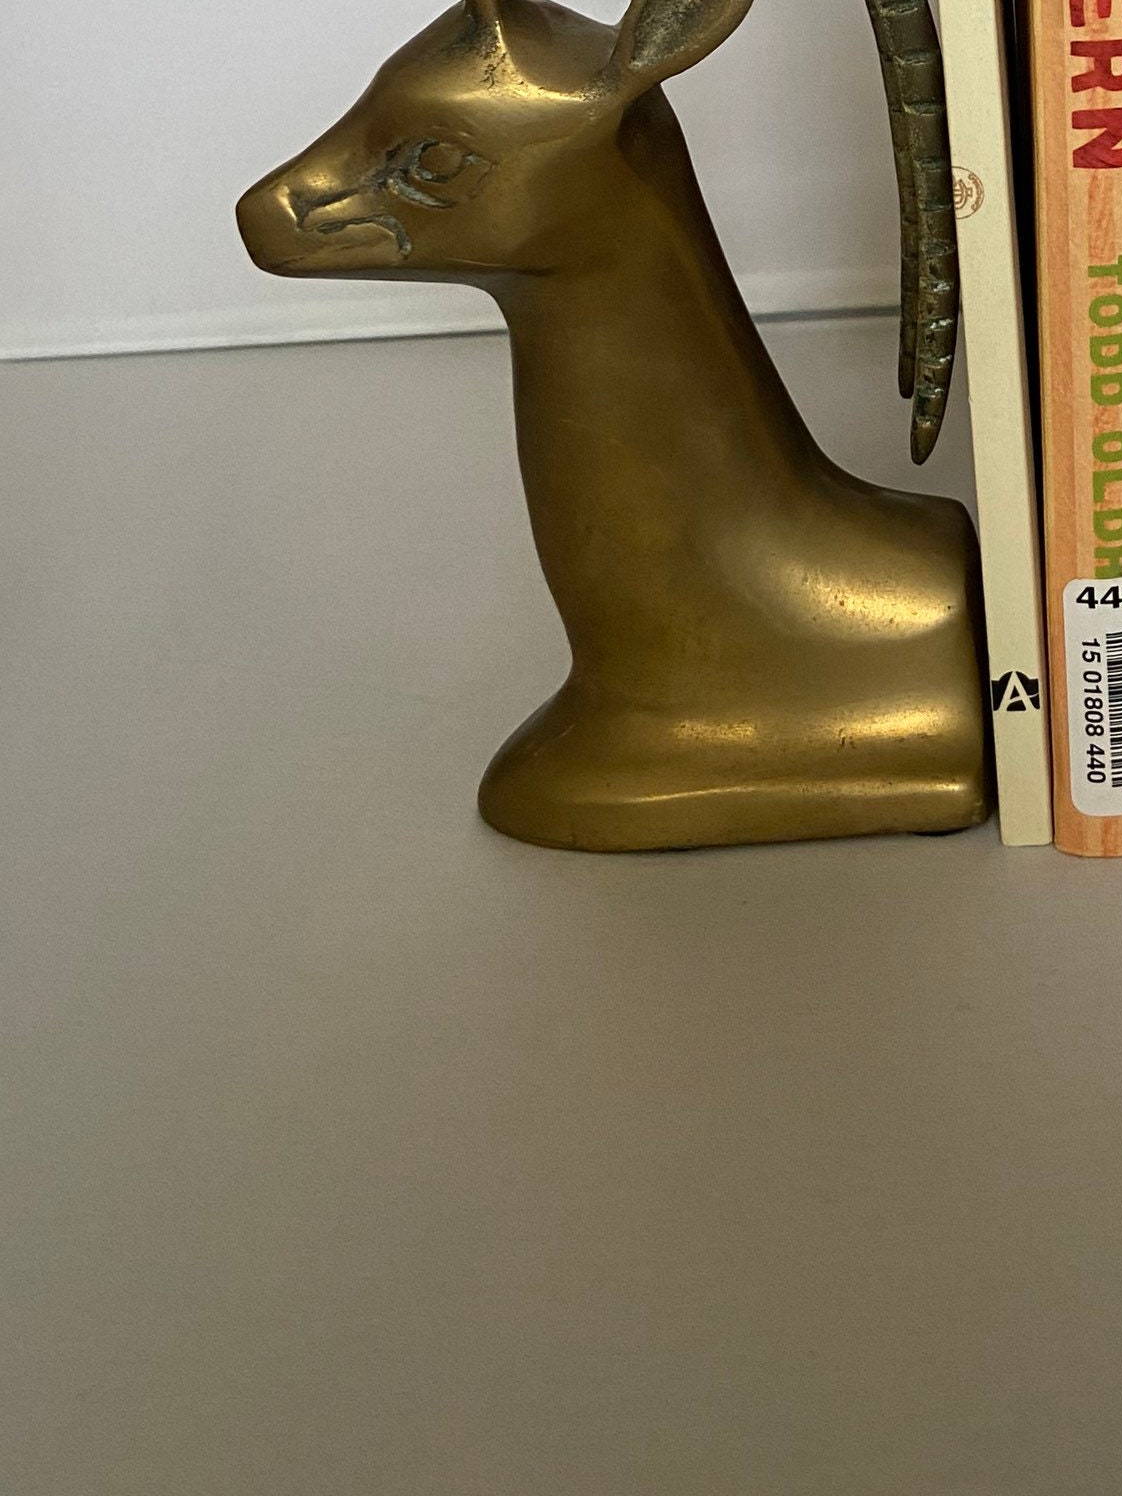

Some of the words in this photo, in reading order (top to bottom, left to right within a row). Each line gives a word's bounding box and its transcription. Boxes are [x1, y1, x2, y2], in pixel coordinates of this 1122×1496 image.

[1082, 637, 1101, 664] 15
[1083, 670, 1104, 737] 01808
[1086, 744, 1106, 784] 440
